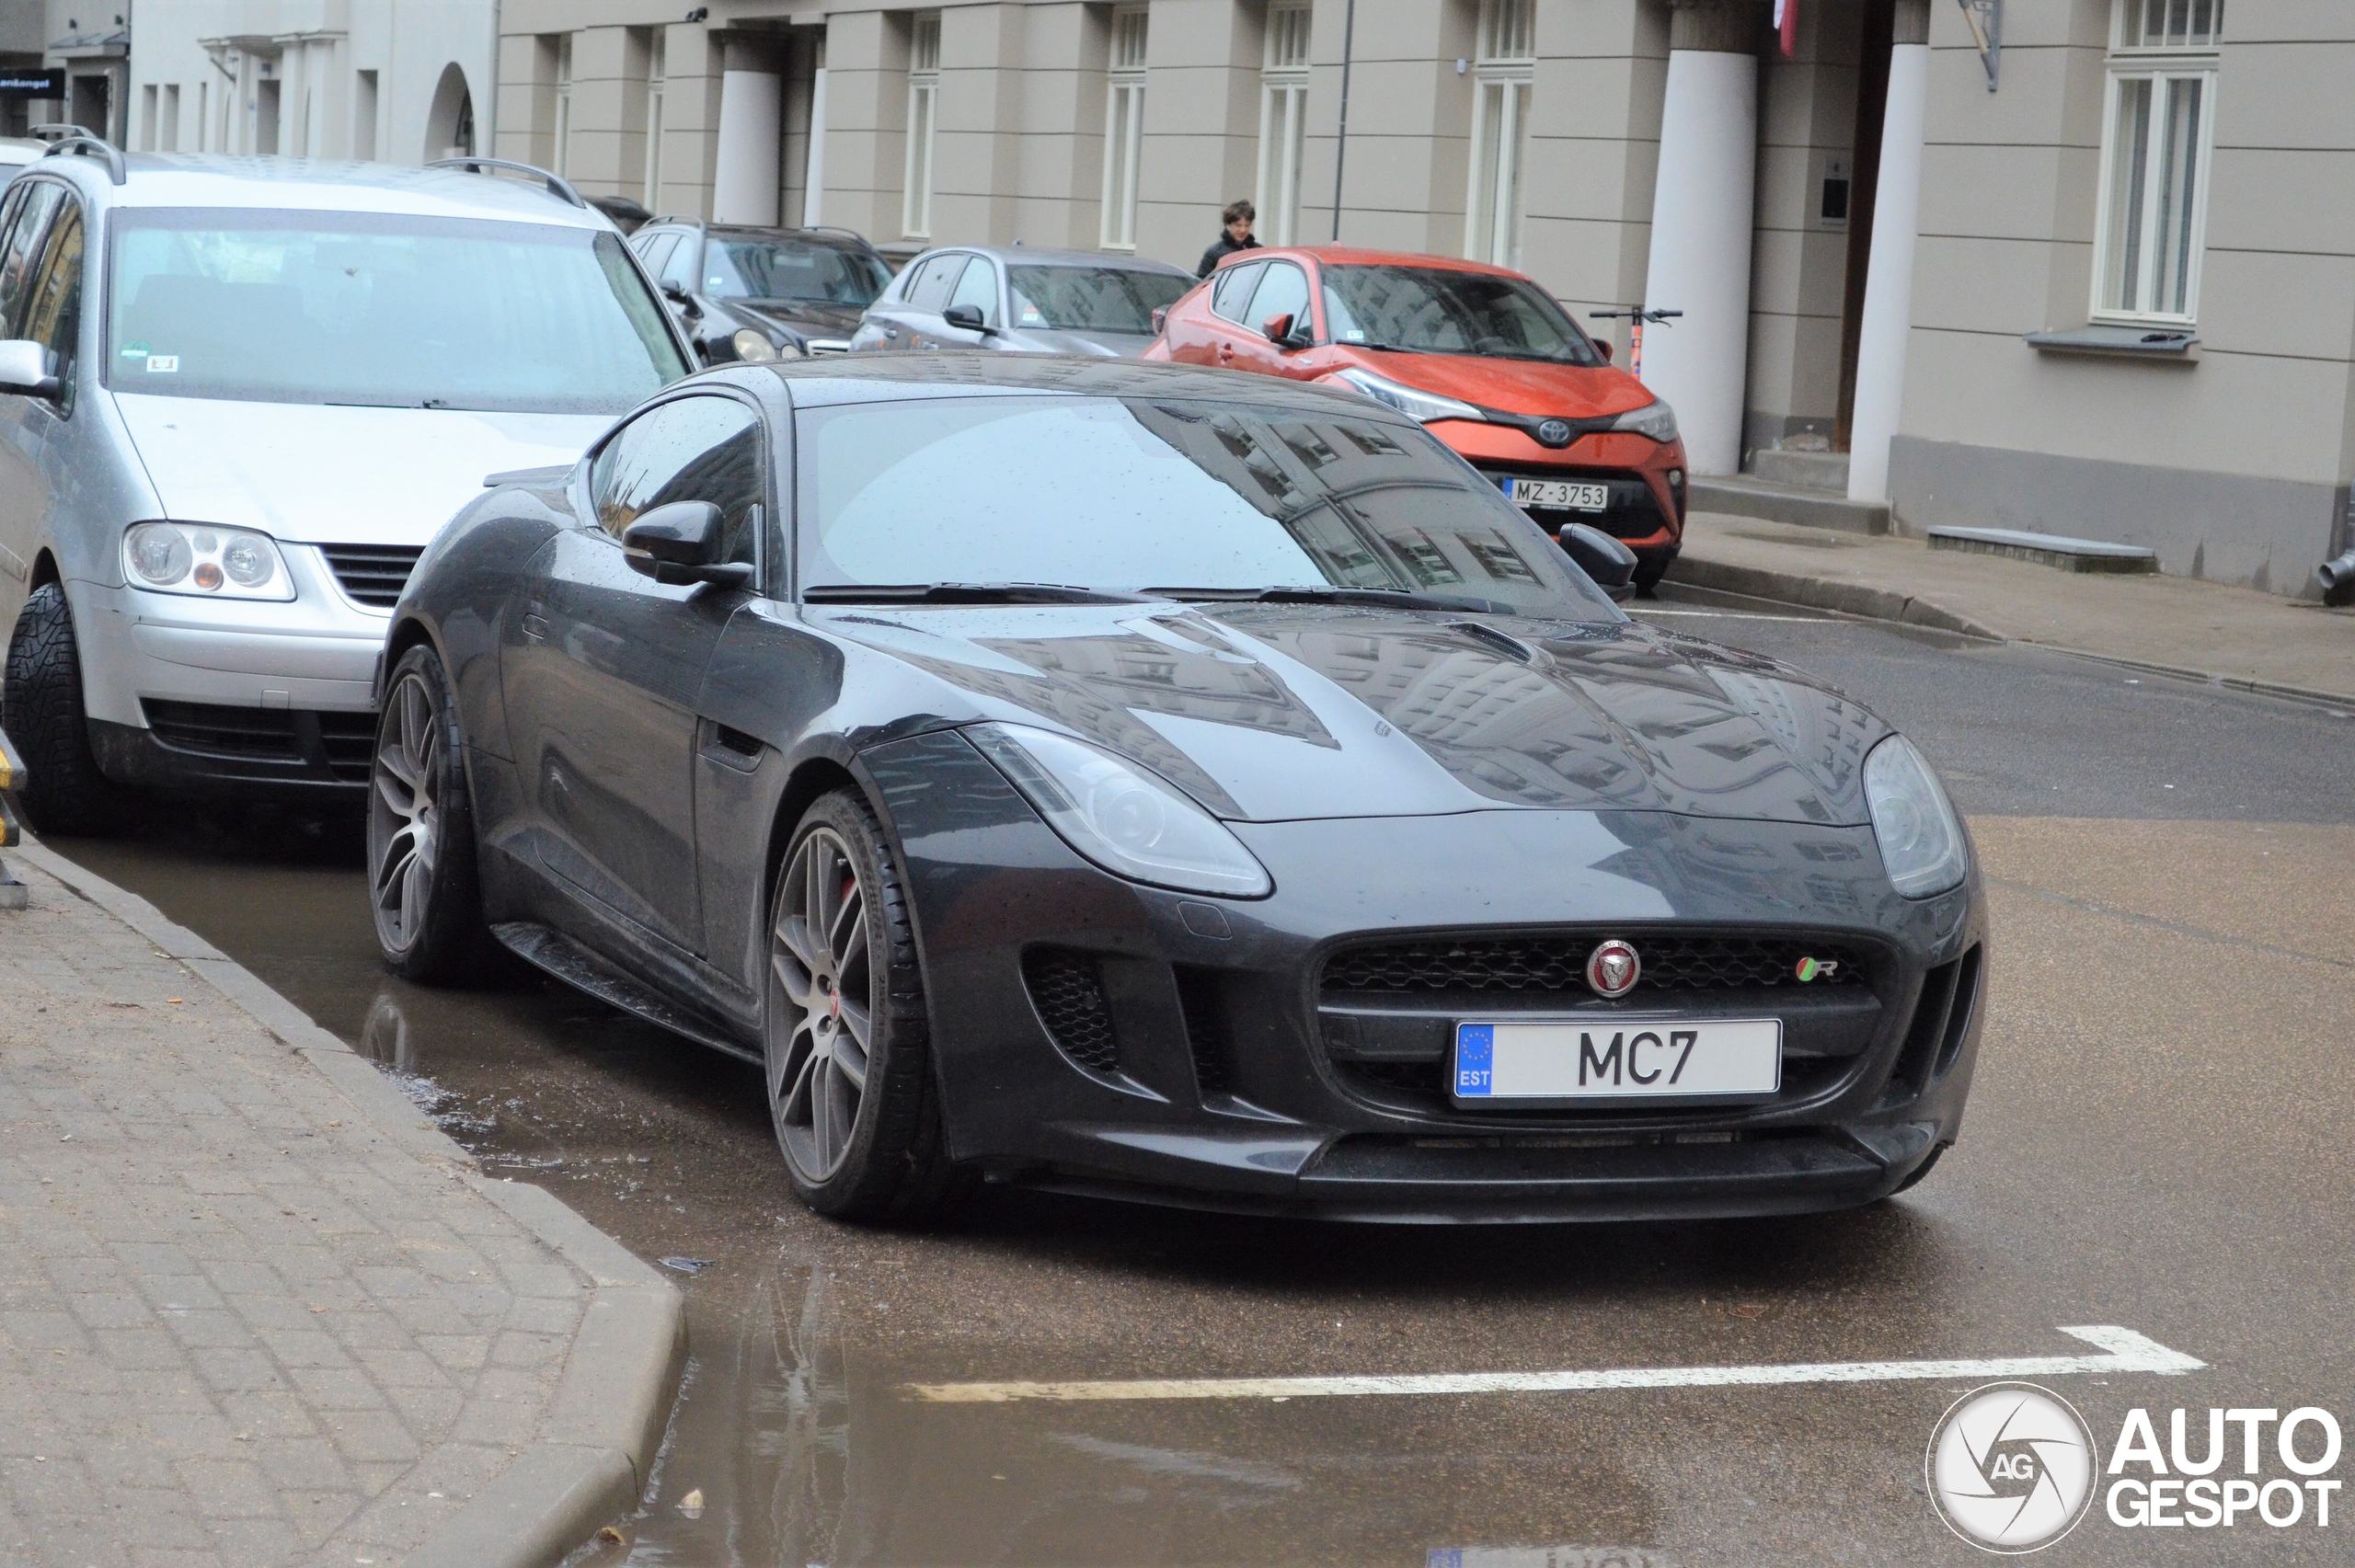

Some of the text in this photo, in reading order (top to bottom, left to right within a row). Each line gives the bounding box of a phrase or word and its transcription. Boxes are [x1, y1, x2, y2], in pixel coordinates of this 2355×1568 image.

[1517, 482, 1603, 505] MZ-3753
[1595, 941, 1637, 957] JAGUAR
[1811, 961, 1838, 977] R
[1460, 1030, 1698, 1086] EST MC7
